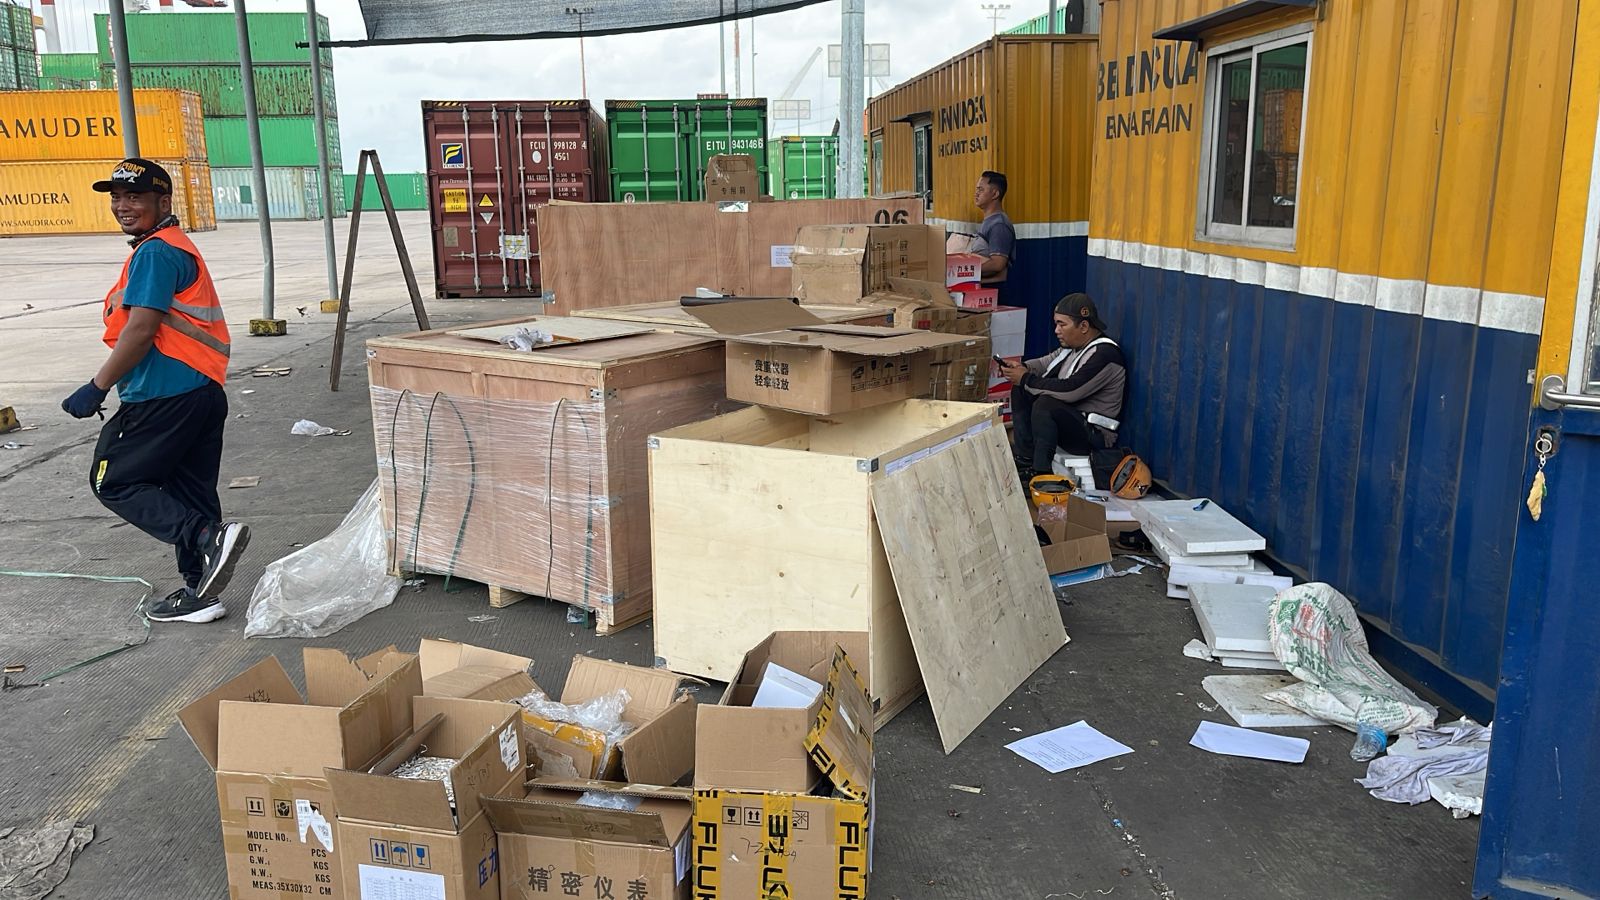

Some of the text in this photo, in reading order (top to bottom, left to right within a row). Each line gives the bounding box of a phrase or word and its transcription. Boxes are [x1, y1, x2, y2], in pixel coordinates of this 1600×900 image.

[0, 116, 118, 138] AMUDER
[530, 140, 587, 150] FCIU 998128 4
[706, 141, 726, 150] EITU
[247, 830, 274, 840] MODEL
[311, 848, 327, 858] PCS
[313, 861, 329, 870] KGS
[315, 874, 331, 883] KGS
[527, 866, 649, 900] 精密仪表
[319, 887, 332, 896] CM
